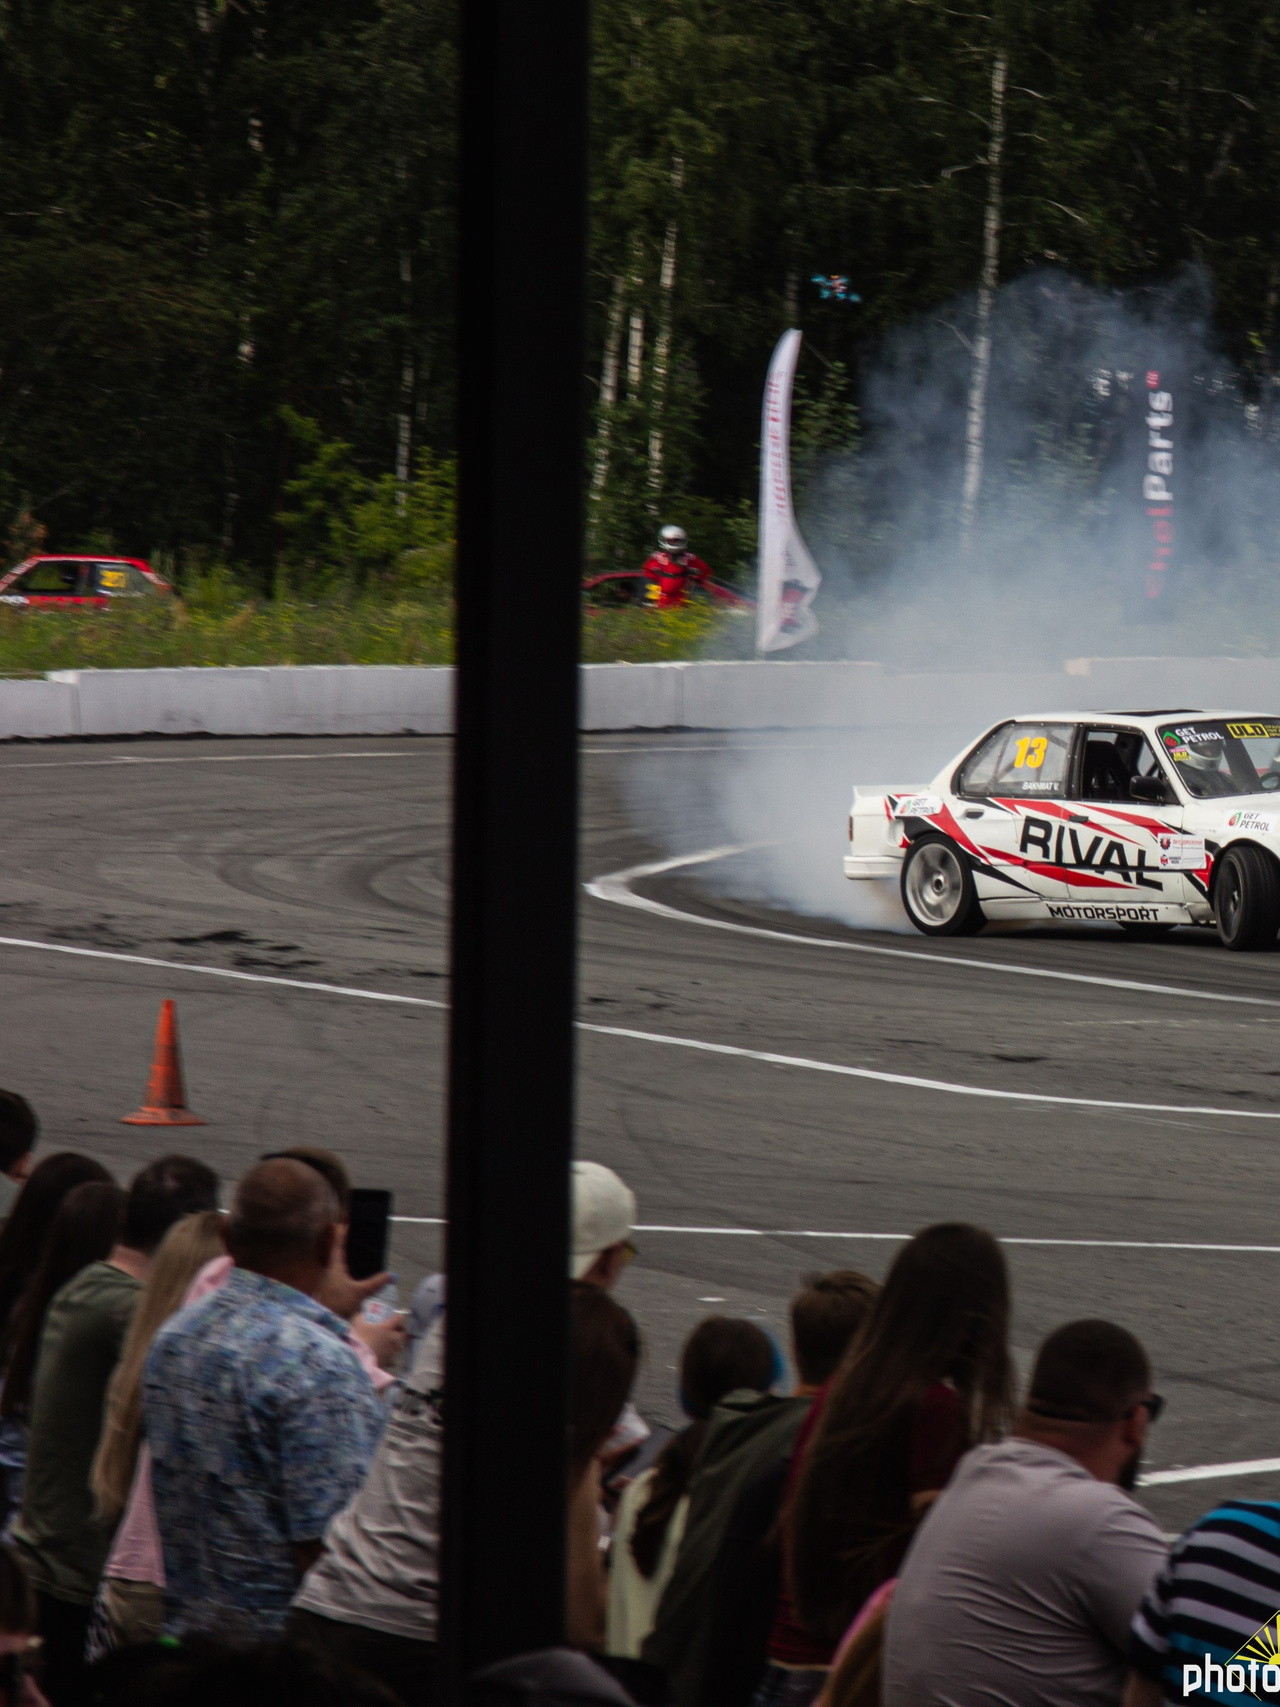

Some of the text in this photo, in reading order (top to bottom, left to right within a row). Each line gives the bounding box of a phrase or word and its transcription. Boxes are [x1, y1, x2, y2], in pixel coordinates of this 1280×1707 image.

[1174, 727, 1197, 737] GET
[1229, 724, 1267, 737] ULD
[1181, 732, 1224, 744] PETROL
[1014, 736, 1048, 768] 13
[1243, 812, 1260, 820] GET
[1239, 820, 1270, 832] PETROL
[1020, 815, 1163, 892] RIVAL
[1049, 905, 1160, 921] MOTORSPORT
